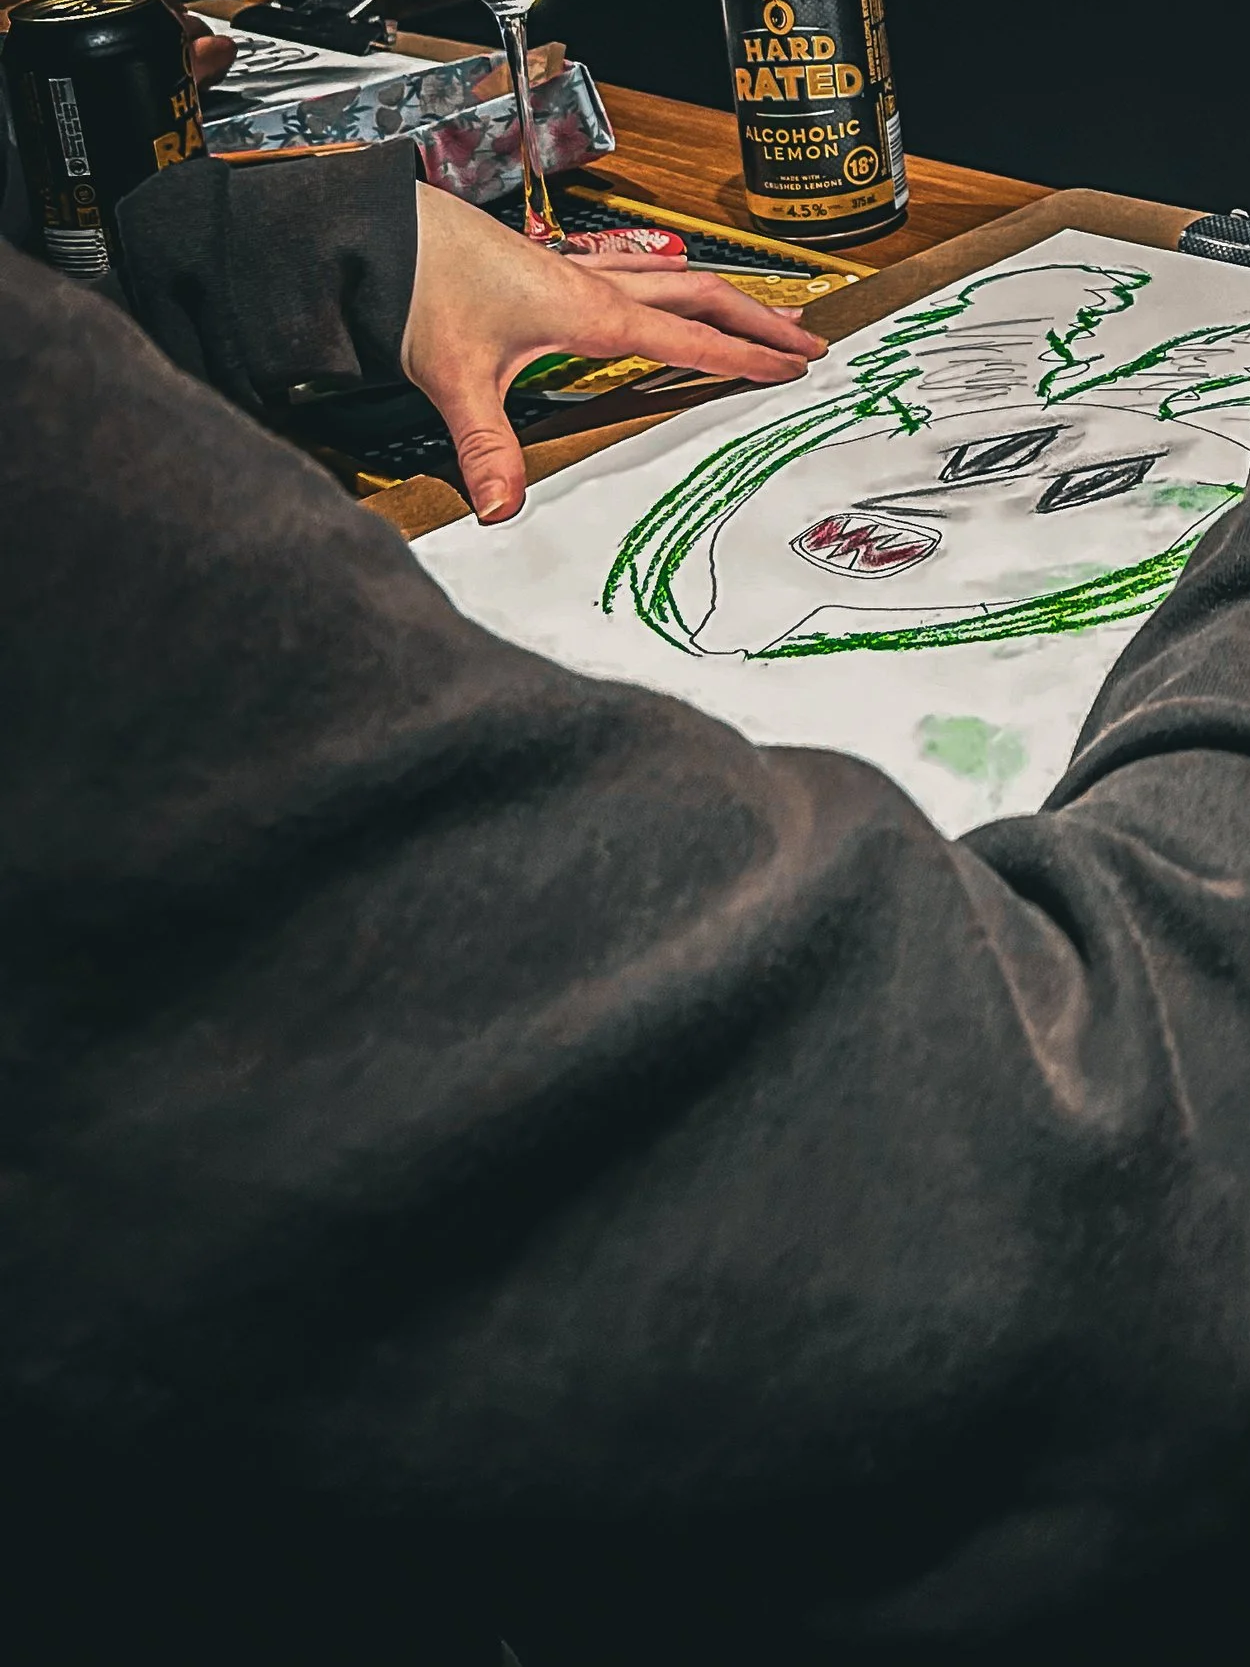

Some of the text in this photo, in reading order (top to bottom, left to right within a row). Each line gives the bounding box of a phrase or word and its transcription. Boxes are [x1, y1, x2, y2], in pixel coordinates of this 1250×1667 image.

[743, 35, 836, 63] HARD
[735, 63, 864, 102] RATED
[744, 118, 861, 145] ALCOHOLIC
[763, 142, 841, 163] LEMON
[786, 202, 829, 218] 4.5%
